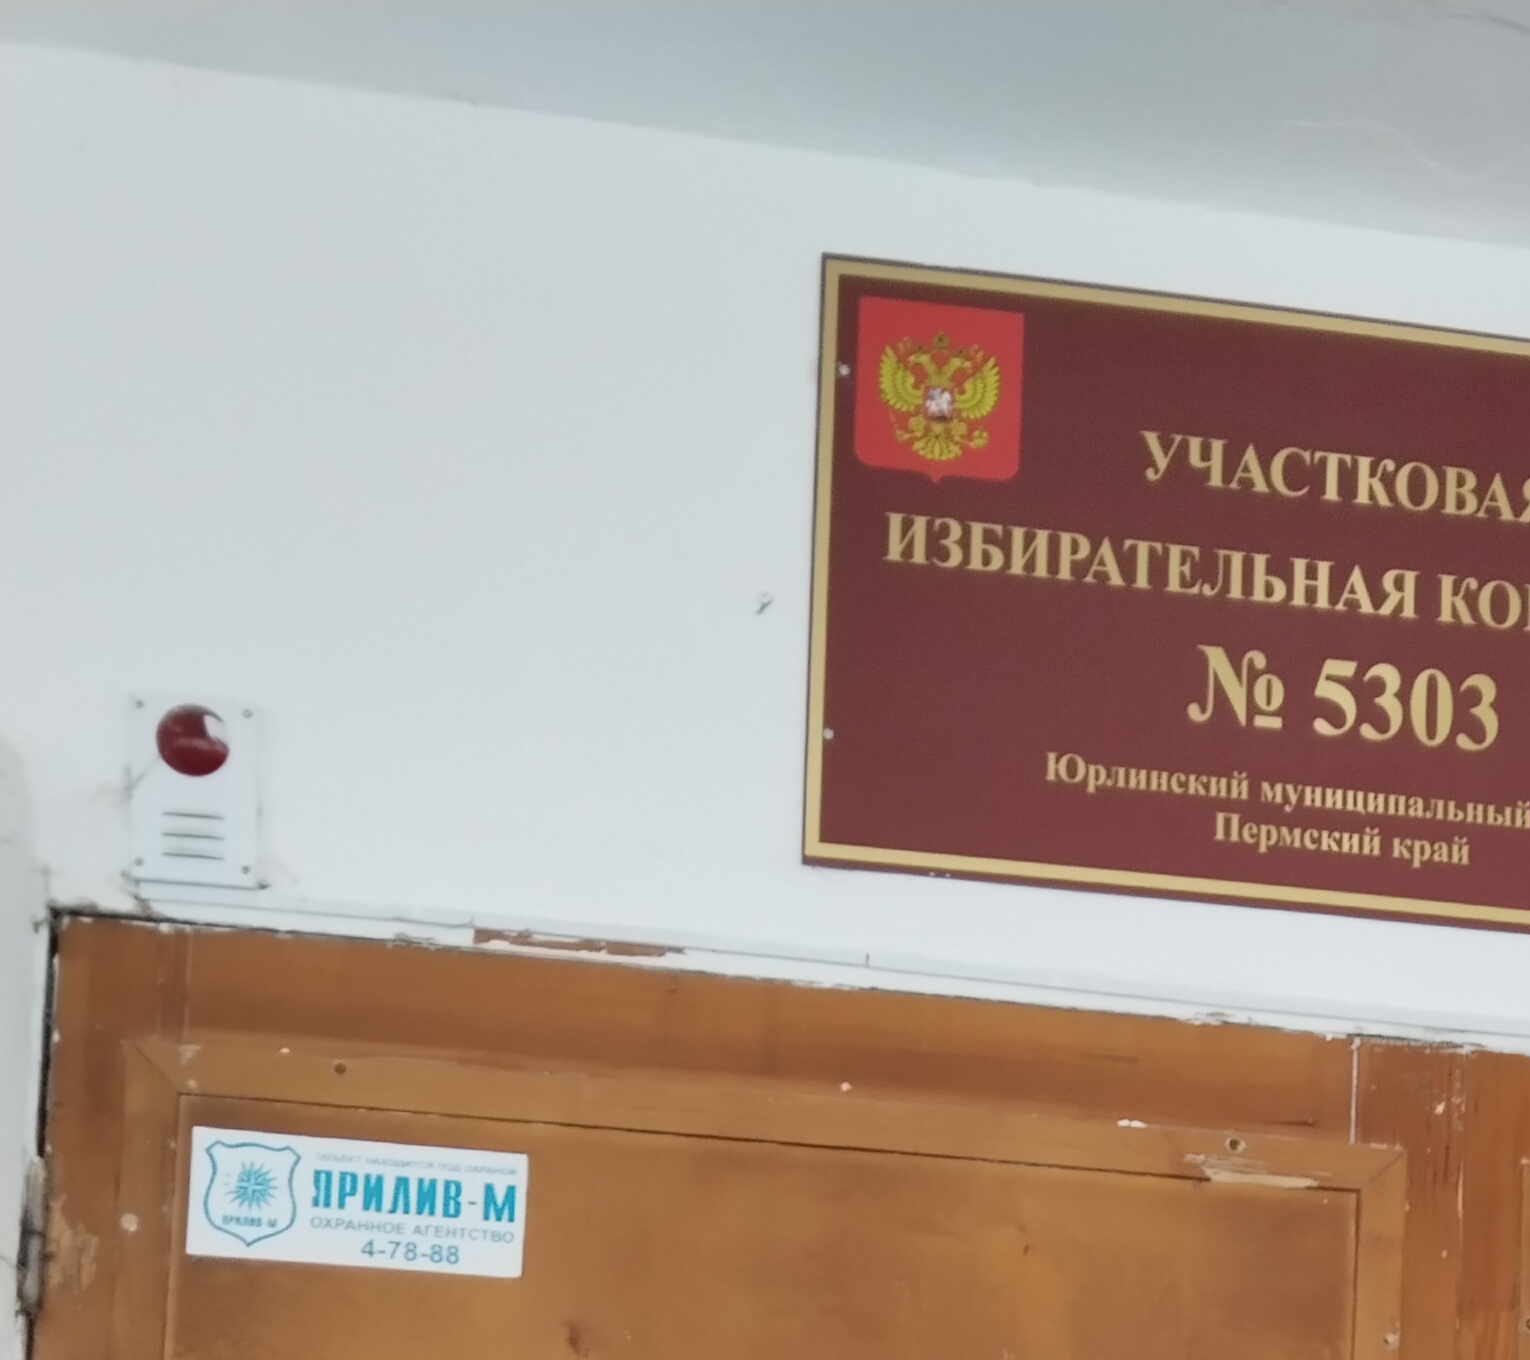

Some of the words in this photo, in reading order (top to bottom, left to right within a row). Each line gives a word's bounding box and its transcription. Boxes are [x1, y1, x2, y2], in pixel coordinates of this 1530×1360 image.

[884, 510, 1417, 620] ИЗБИРАТЕЛЬНАЯ
[1187, 644, 1286, 730] №
[1312, 658, 1501, 752] 5303
[1045, 752, 1250, 803] Юрлинский
[1214, 813, 1382, 858] Пермский
[1391, 832, 1470, 867] край
[310, 1215, 405, 1236] ОХРАННОЕ
[413, 1222, 515, 1243] АГЕНТСТВО
[360, 1240, 460, 1265] 4-78-88
